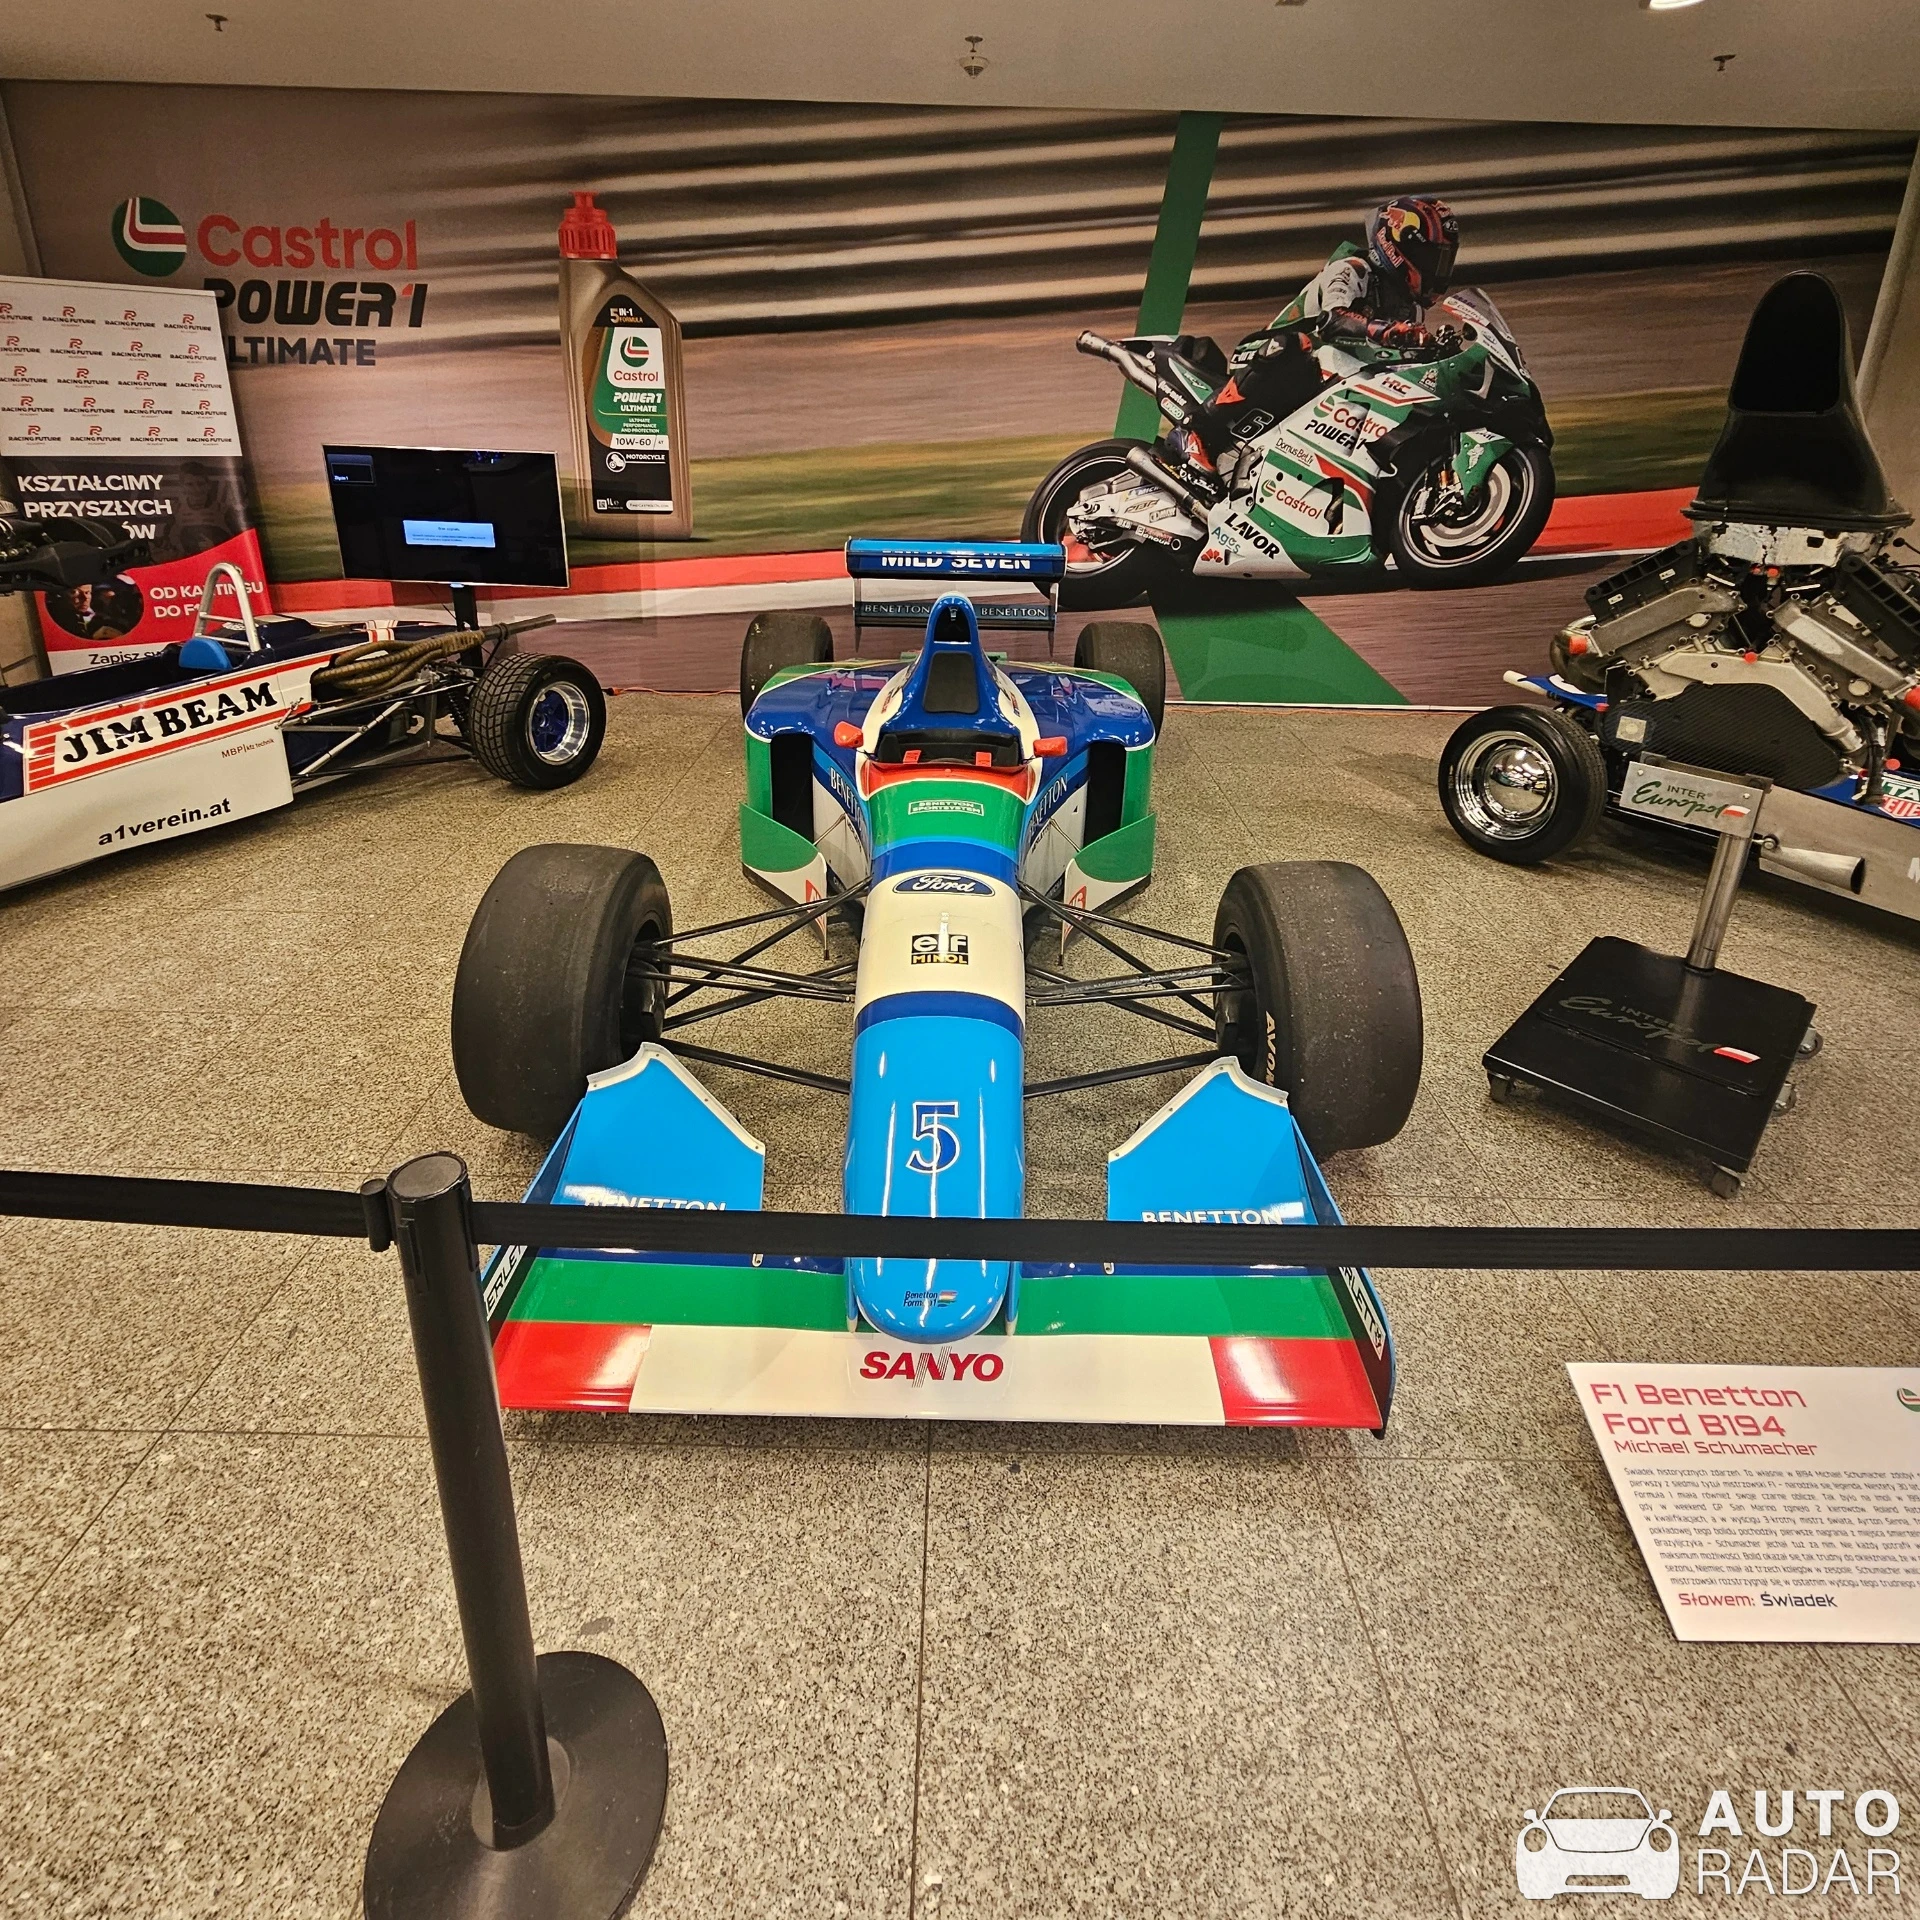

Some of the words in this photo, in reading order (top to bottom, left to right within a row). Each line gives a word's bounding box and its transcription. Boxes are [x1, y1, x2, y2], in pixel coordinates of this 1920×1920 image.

[198, 214, 417, 270] Castrol
[204, 278, 428, 328] POWER1
[610, 308, 619, 323] 5
[619, 308, 633, 316] IN-1
[224, 336, 376, 366] LTIMATE
[614, 370, 658, 381] Castrol
[1382, 377, 1411, 394] HRC
[613, 392, 662, 403] POWER1
[1230, 408, 1274, 441] 6
[1334, 408, 1388, 438] Castro
[616, 438, 651, 446] 10W-60
[18, 474, 164, 492] KSZTAŁCIMY
[24, 499, 172, 518] PRZYSZŁYCH
[1276, 489, 1322, 519] Castrol
[1225, 513, 1280, 559] LAVOR
[882, 550, 943, 567] MILD
[951, 550, 1030, 570] SEVEN
[150, 587, 177, 599] OD
[180, 582, 264, 597] KATINGU
[154, 605, 181, 618] DO
[864, 604, 931, 614] BENETTON
[981, 607, 1046, 617] BENETTON
[89, 653, 139, 665] Zapisz
[63, 716, 154, 763] JIM
[152, 682, 278, 738] BEAM
[1667, 785, 1706, 799] INTER
[1888, 782, 1920, 801] TA
[912, 805, 981, 814] SPORTSYSTEM
[1884, 798, 1920, 816] EUE
[98, 798, 231, 846] a1verein.at
[912, 875, 974, 892] Ford
[913, 955, 967, 963] MINOL
[1620, 1006, 1694, 1033] INTER
[1265, 1010, 1276, 1086] AVON
[906, 1102, 960, 1174] 5
[905, 1291, 938, 1299] Benetton
[860, 1346, 1004, 1388] SANYO
[1590, 1383, 1628, 1405] F1
[1635, 1384, 1807, 1408] Benetton
[1603, 1412, 1691, 1436] Ford
[1698, 1414, 1786, 1437] B194
[1614, 1440, 1689, 1454] Michael
[1694, 1441, 1818, 1456] Schumacher
[1679, 1593, 1755, 1607] Słowem:
[1761, 1591, 1838, 1607] Świadek
